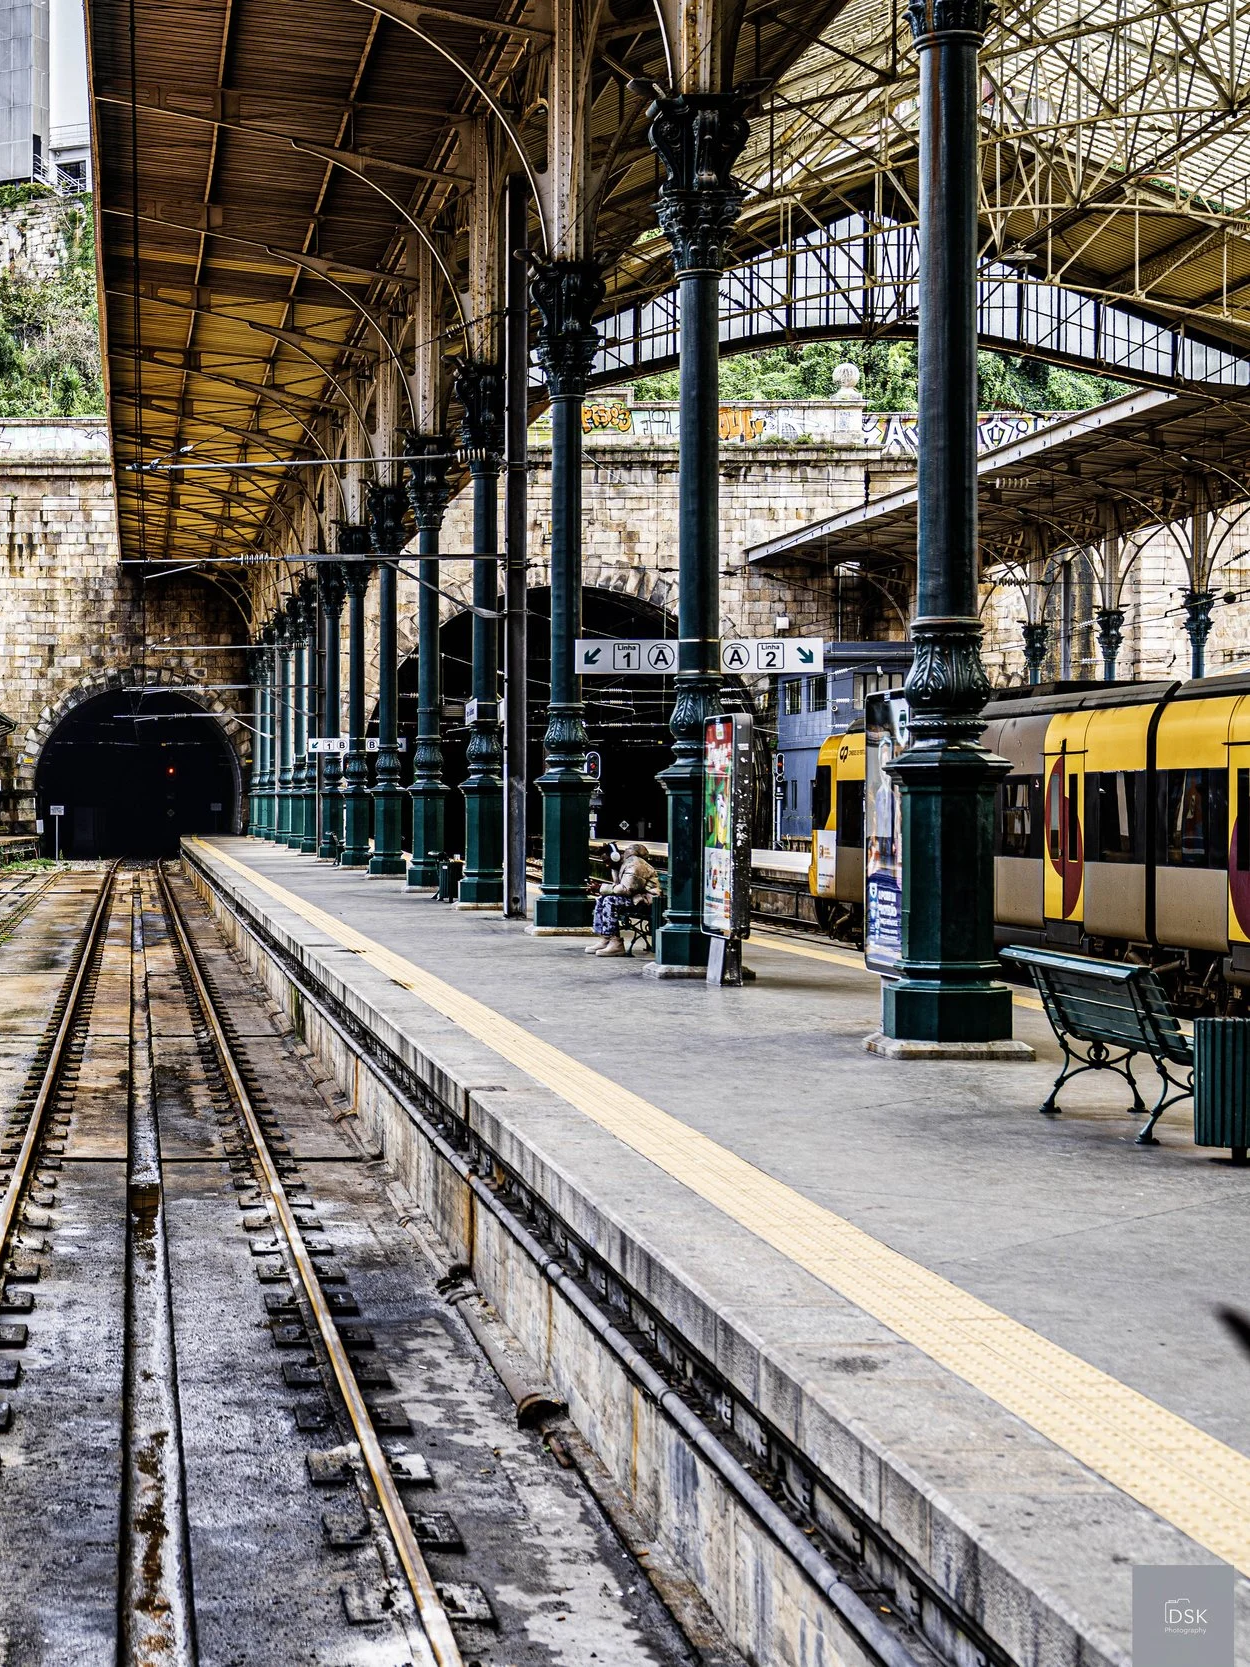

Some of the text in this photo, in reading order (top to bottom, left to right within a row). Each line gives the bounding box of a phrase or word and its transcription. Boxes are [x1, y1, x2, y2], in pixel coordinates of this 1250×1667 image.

[623, 649, 777, 668] 1 A A 2
[339, 741, 345, 749] B
[370, 741, 375, 749] B
